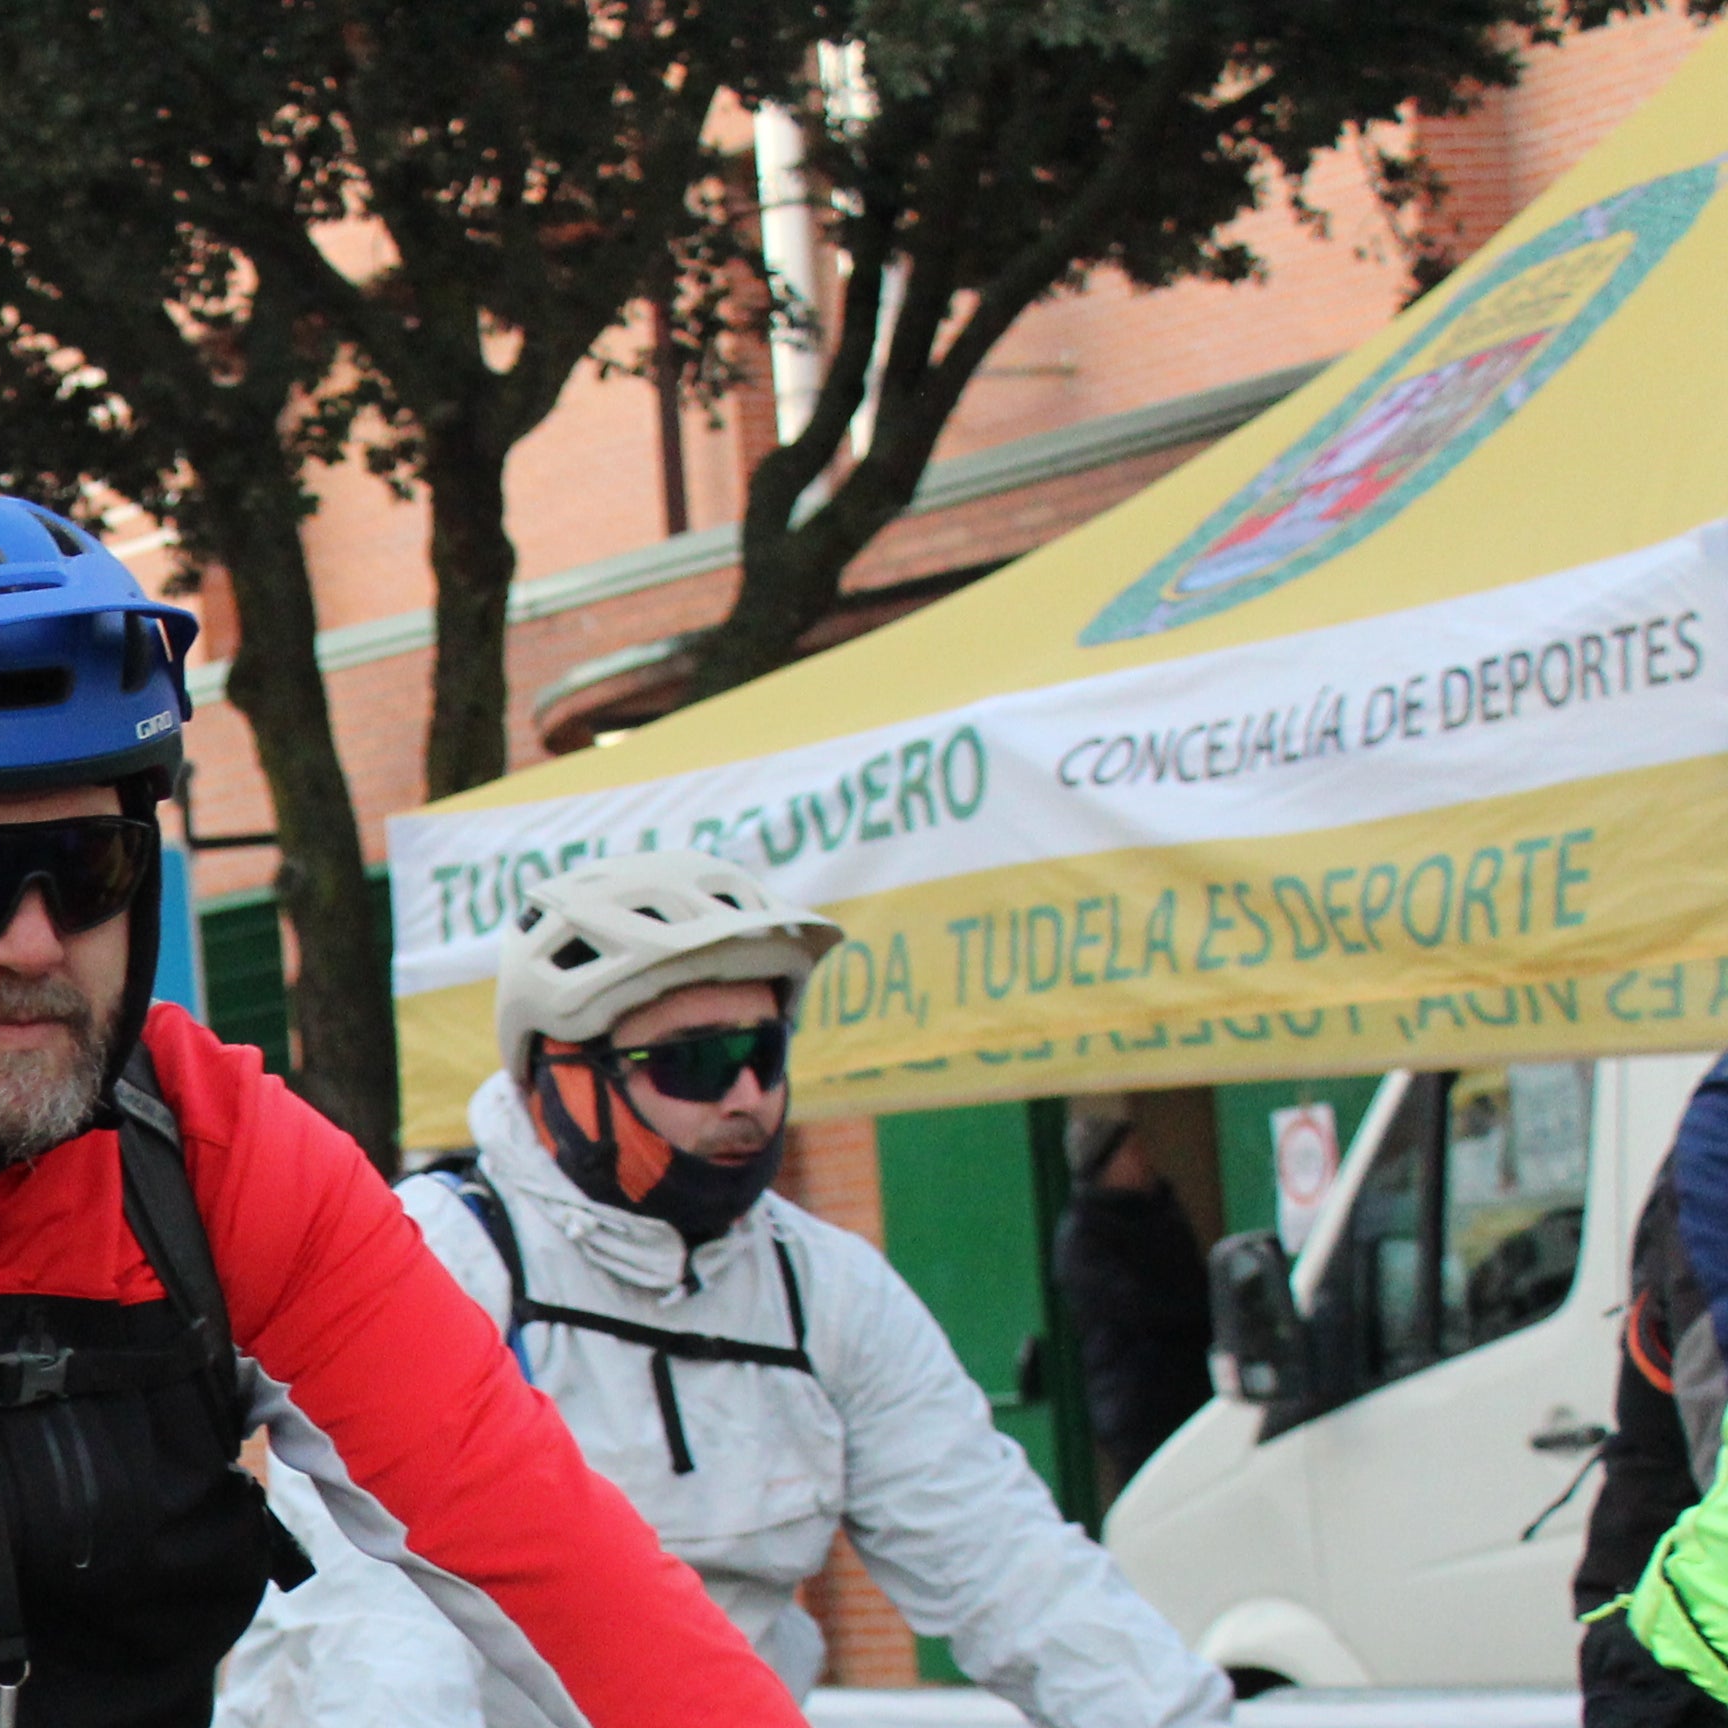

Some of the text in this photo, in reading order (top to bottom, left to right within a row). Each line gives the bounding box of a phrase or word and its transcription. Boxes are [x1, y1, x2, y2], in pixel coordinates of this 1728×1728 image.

[1057, 611, 1704, 787] CONCEJALÍA DE DEPORTES
[794, 828, 1597, 1028] IDA, TUDELA ES DEPORTE
